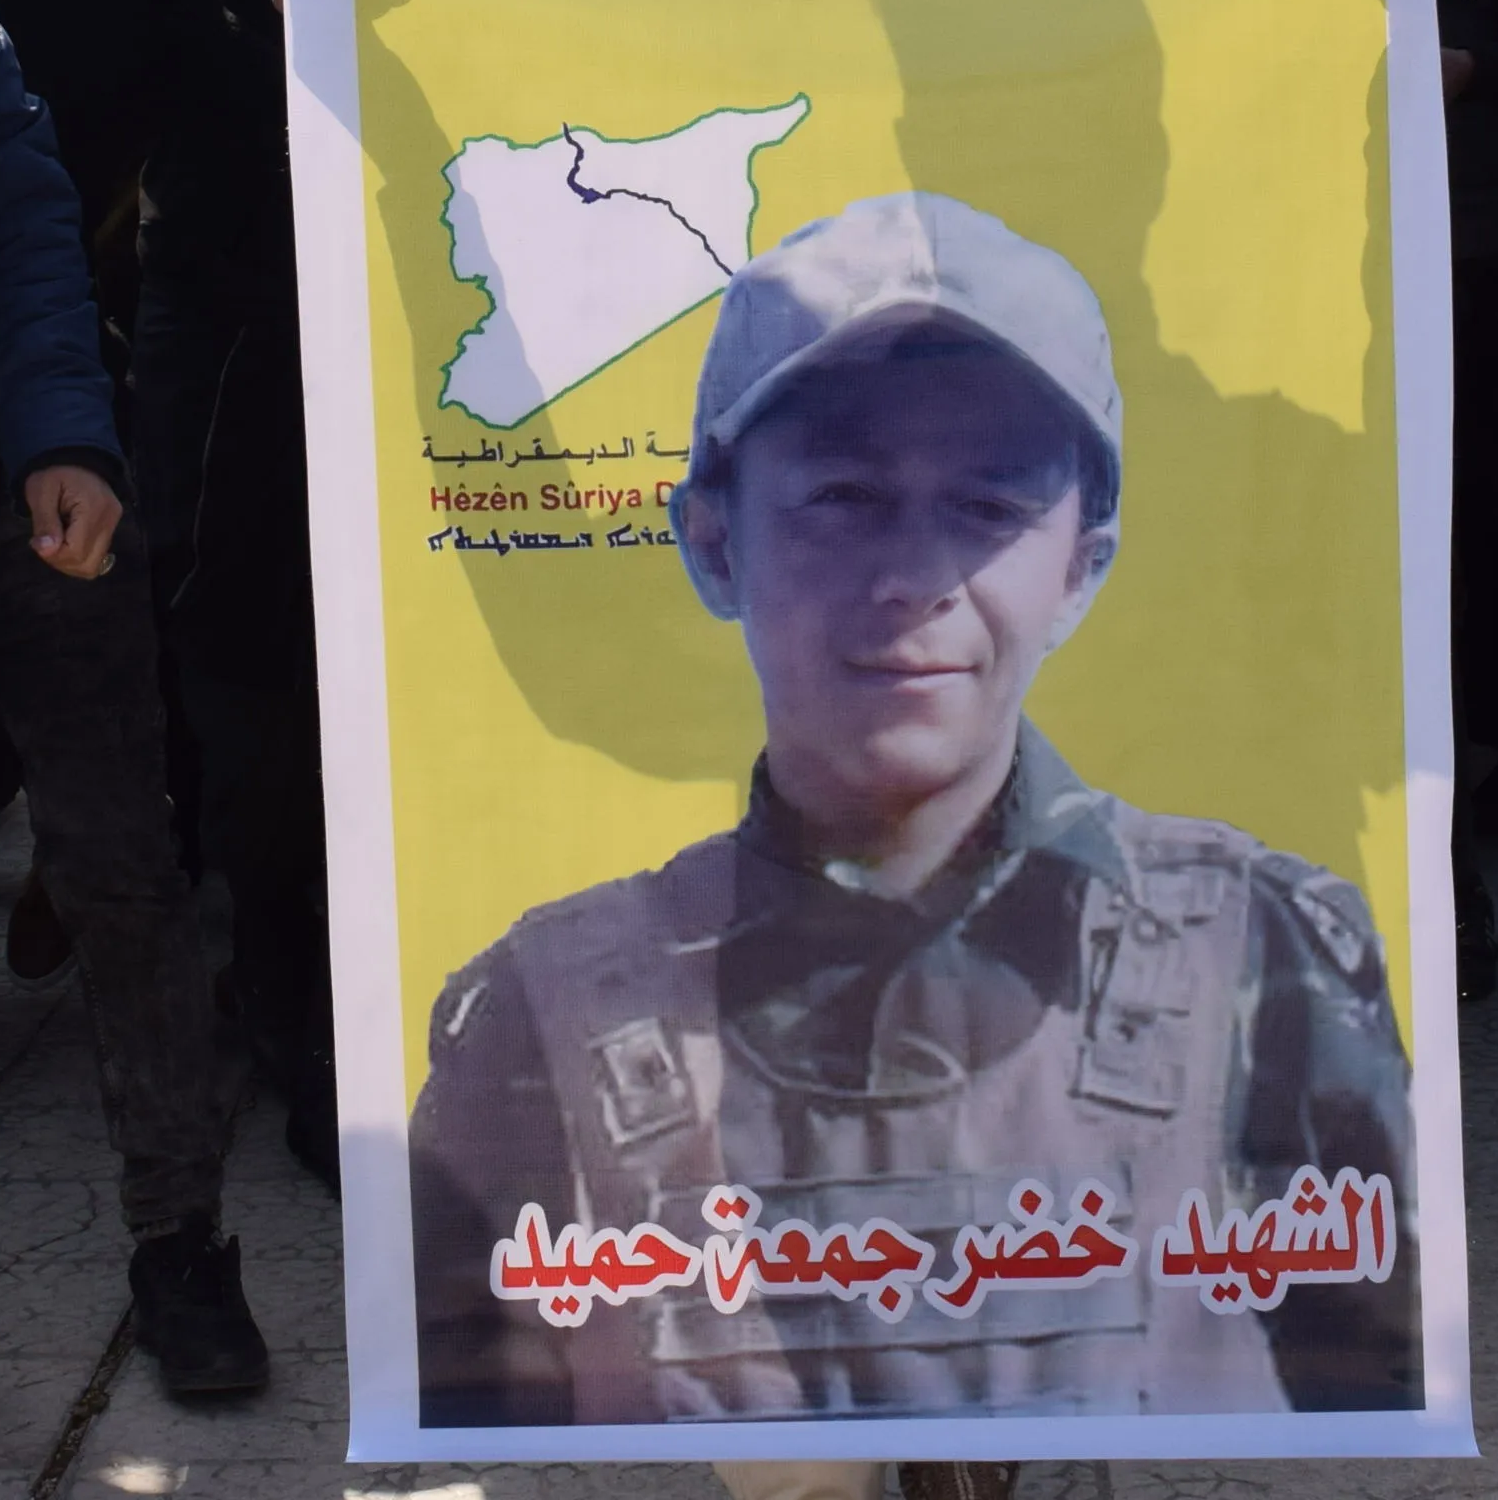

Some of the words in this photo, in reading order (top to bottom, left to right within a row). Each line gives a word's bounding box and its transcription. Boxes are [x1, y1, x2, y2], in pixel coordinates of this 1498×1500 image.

[421, 434, 635, 469] الديمقراطية
[430, 482, 528, 512] Hêzên
[540, 481, 643, 516] Sûriya
[495, 1207, 697, 1322] حميد
[706, 1190, 929, 1318] جمعة
[928, 1182, 1134, 1313] خضر
[1156, 1170, 1391, 1308] الشهيد
